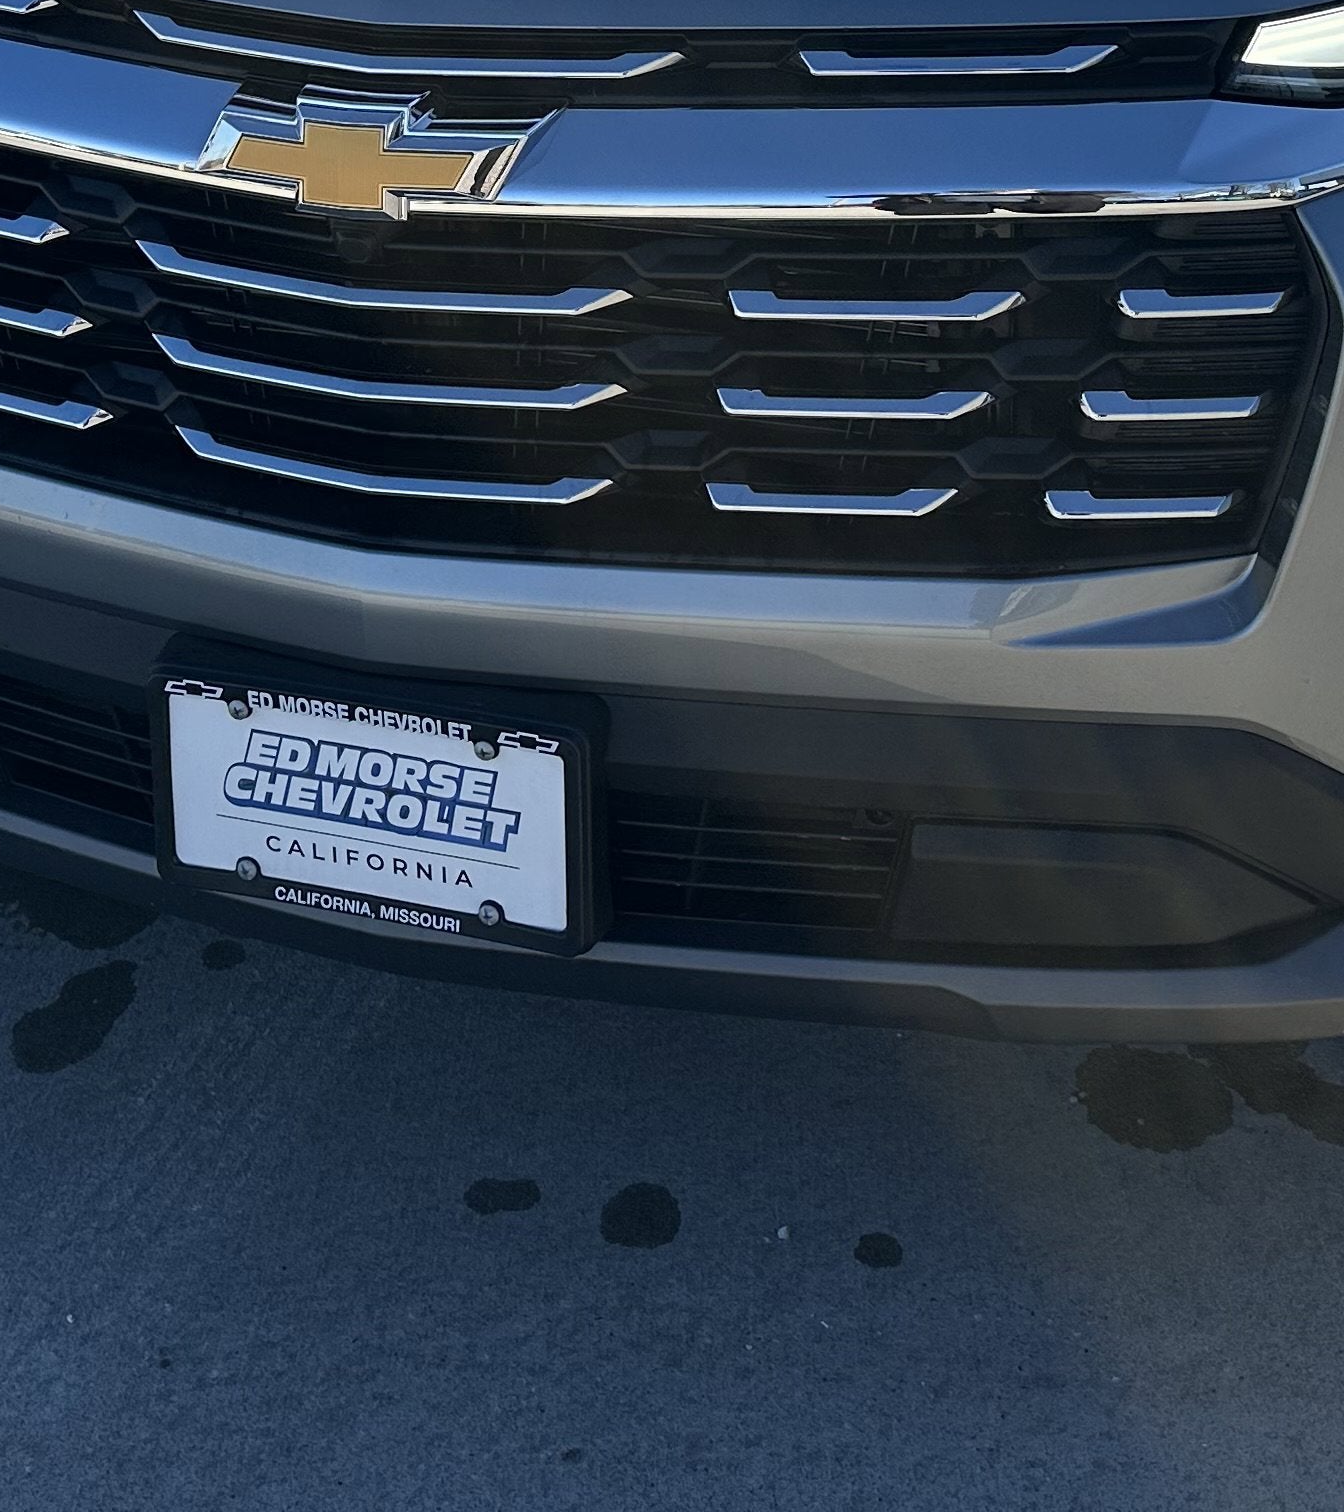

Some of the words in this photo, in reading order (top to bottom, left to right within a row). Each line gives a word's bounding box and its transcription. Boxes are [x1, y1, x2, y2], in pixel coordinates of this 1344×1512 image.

[247, 690, 273, 709] ED
[278, 694, 350, 721] MORSE
[355, 706, 472, 742] CHEVROLET
[246, 730, 312, 774] ED
[314, 739, 498, 807] MORSE
[225, 763, 520, 851] CHEVROLET
[265, 835, 473, 888] CALIFORNIA
[274, 886, 376, 920] CALIFORNIA,
[379, 904, 461, 933] MISSOURI
